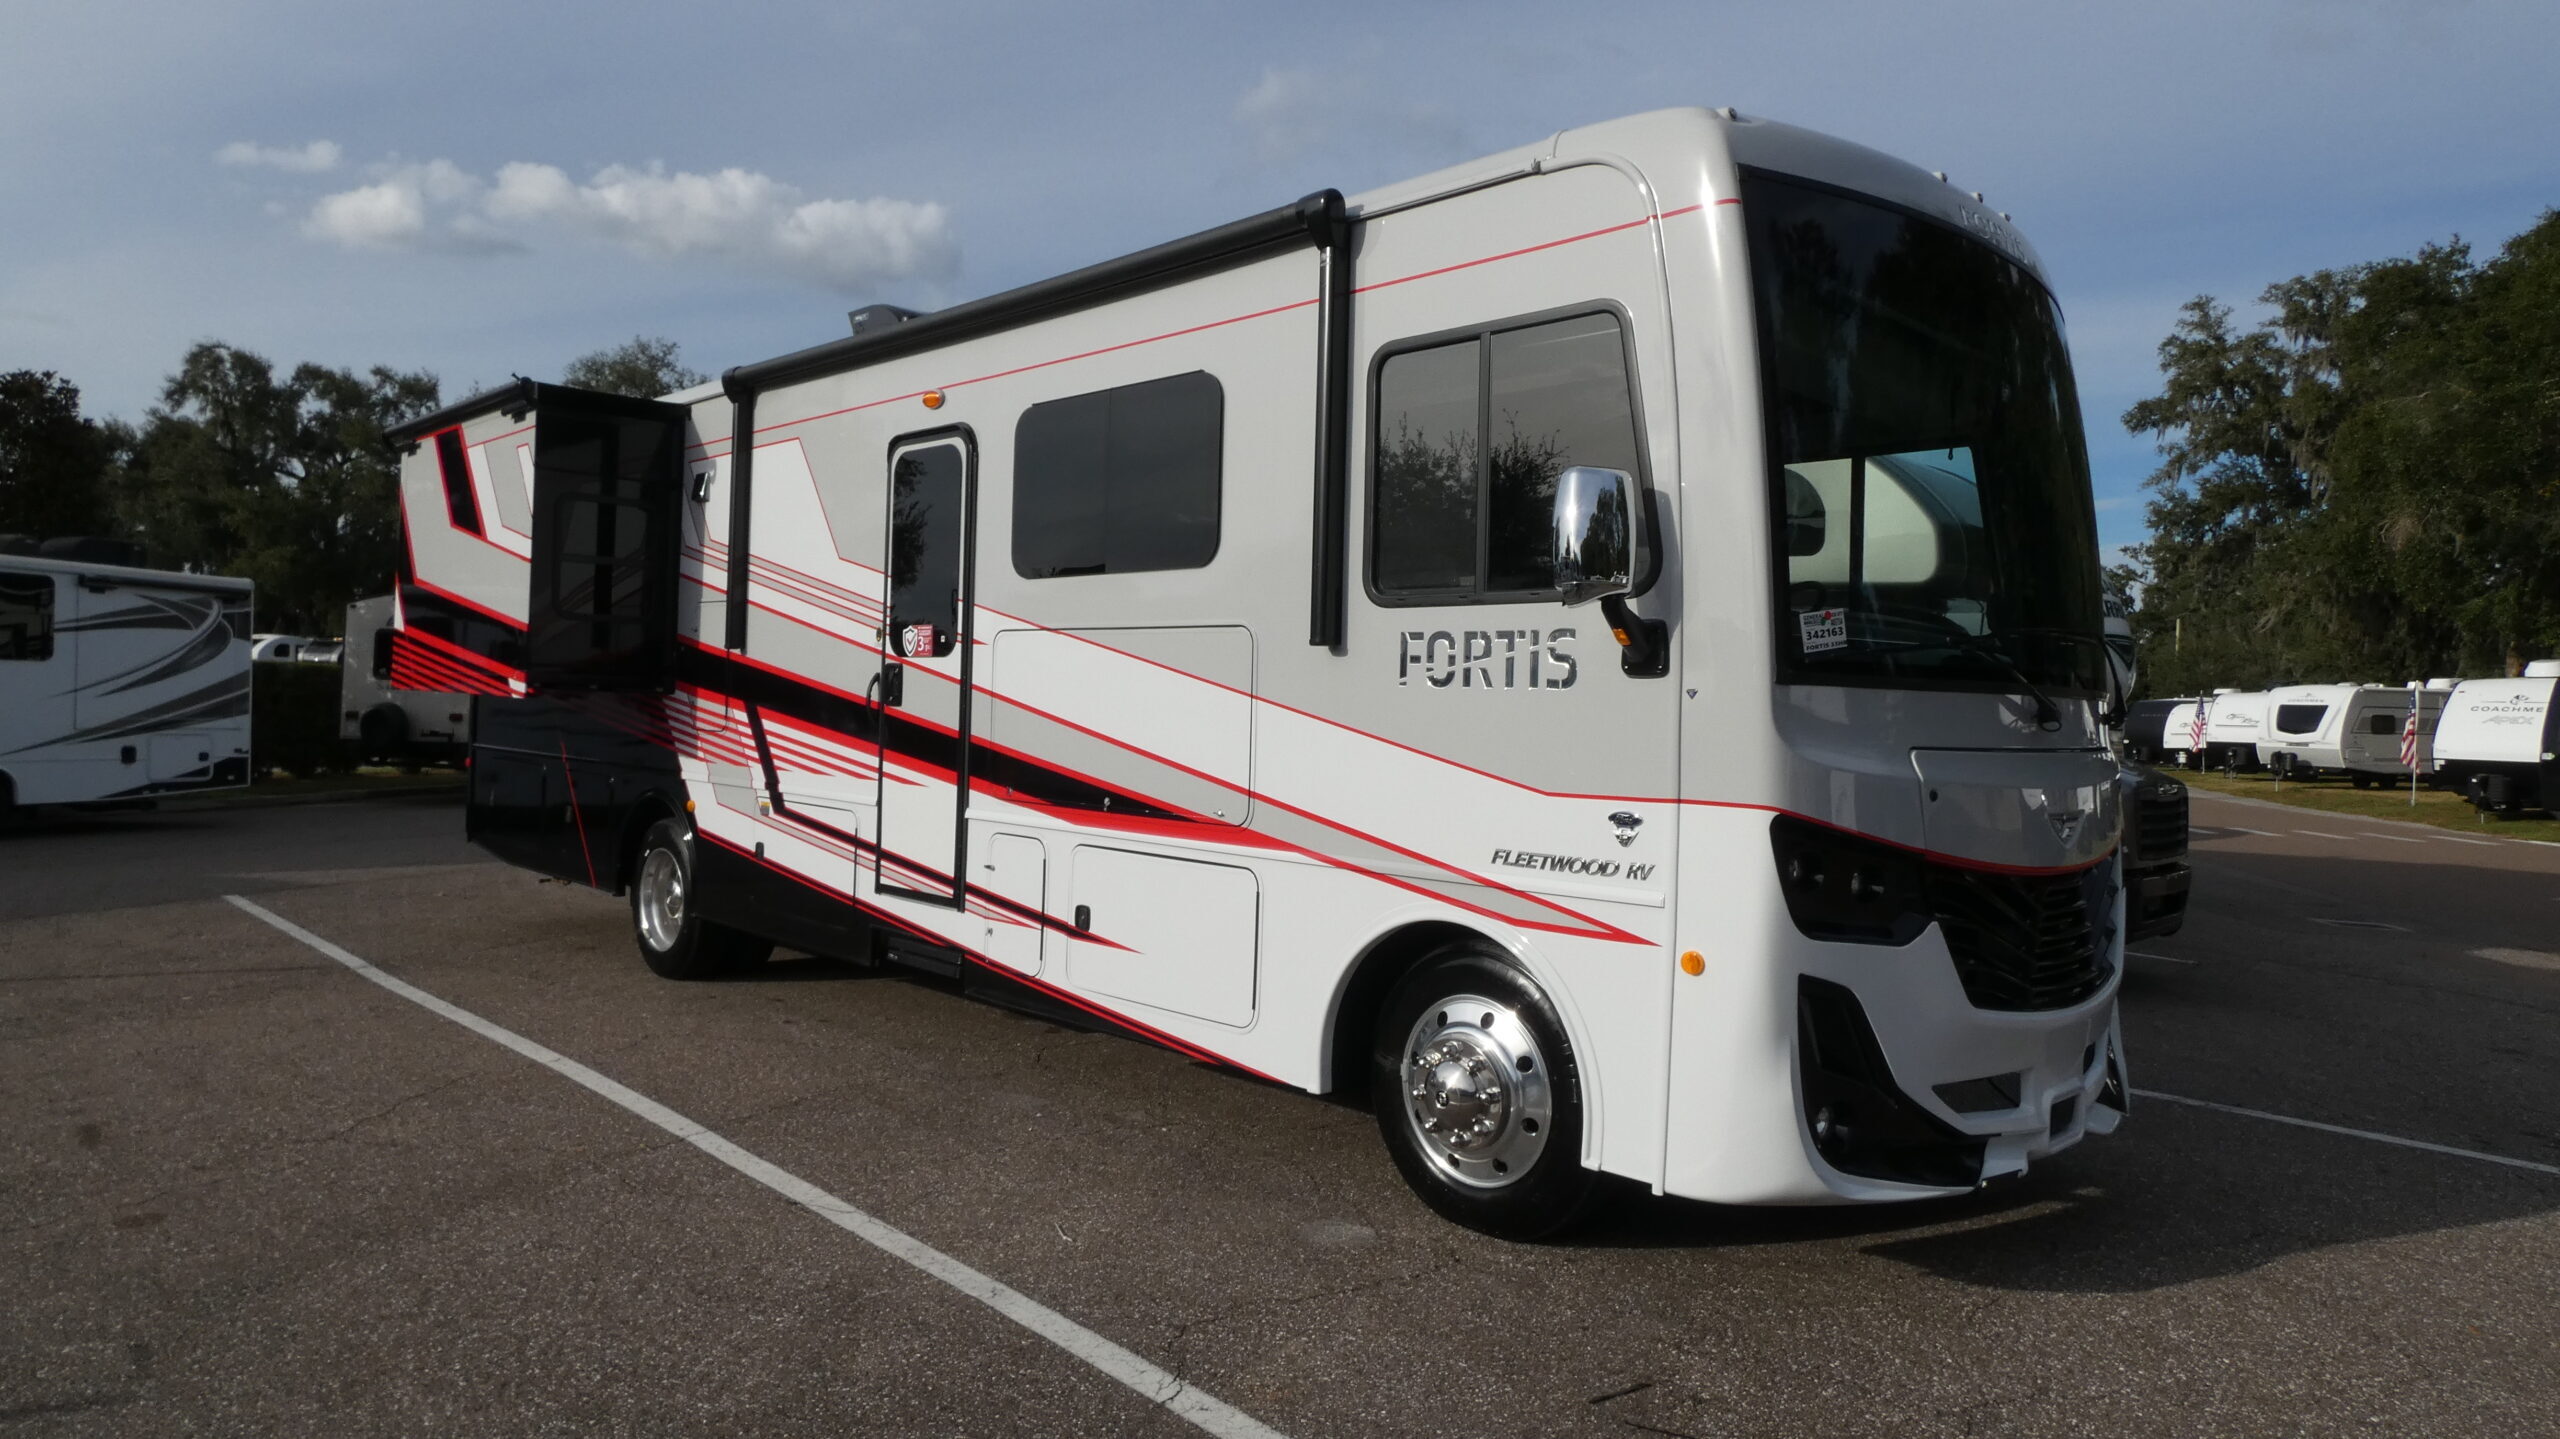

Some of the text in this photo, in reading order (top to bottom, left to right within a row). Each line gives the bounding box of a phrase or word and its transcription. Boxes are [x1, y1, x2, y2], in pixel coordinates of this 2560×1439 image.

[1806, 626, 1844, 641] 342163
[1399, 628, 1577, 690] FORTIS
[1491, 848, 1656, 881] FLEETWOOD RV
